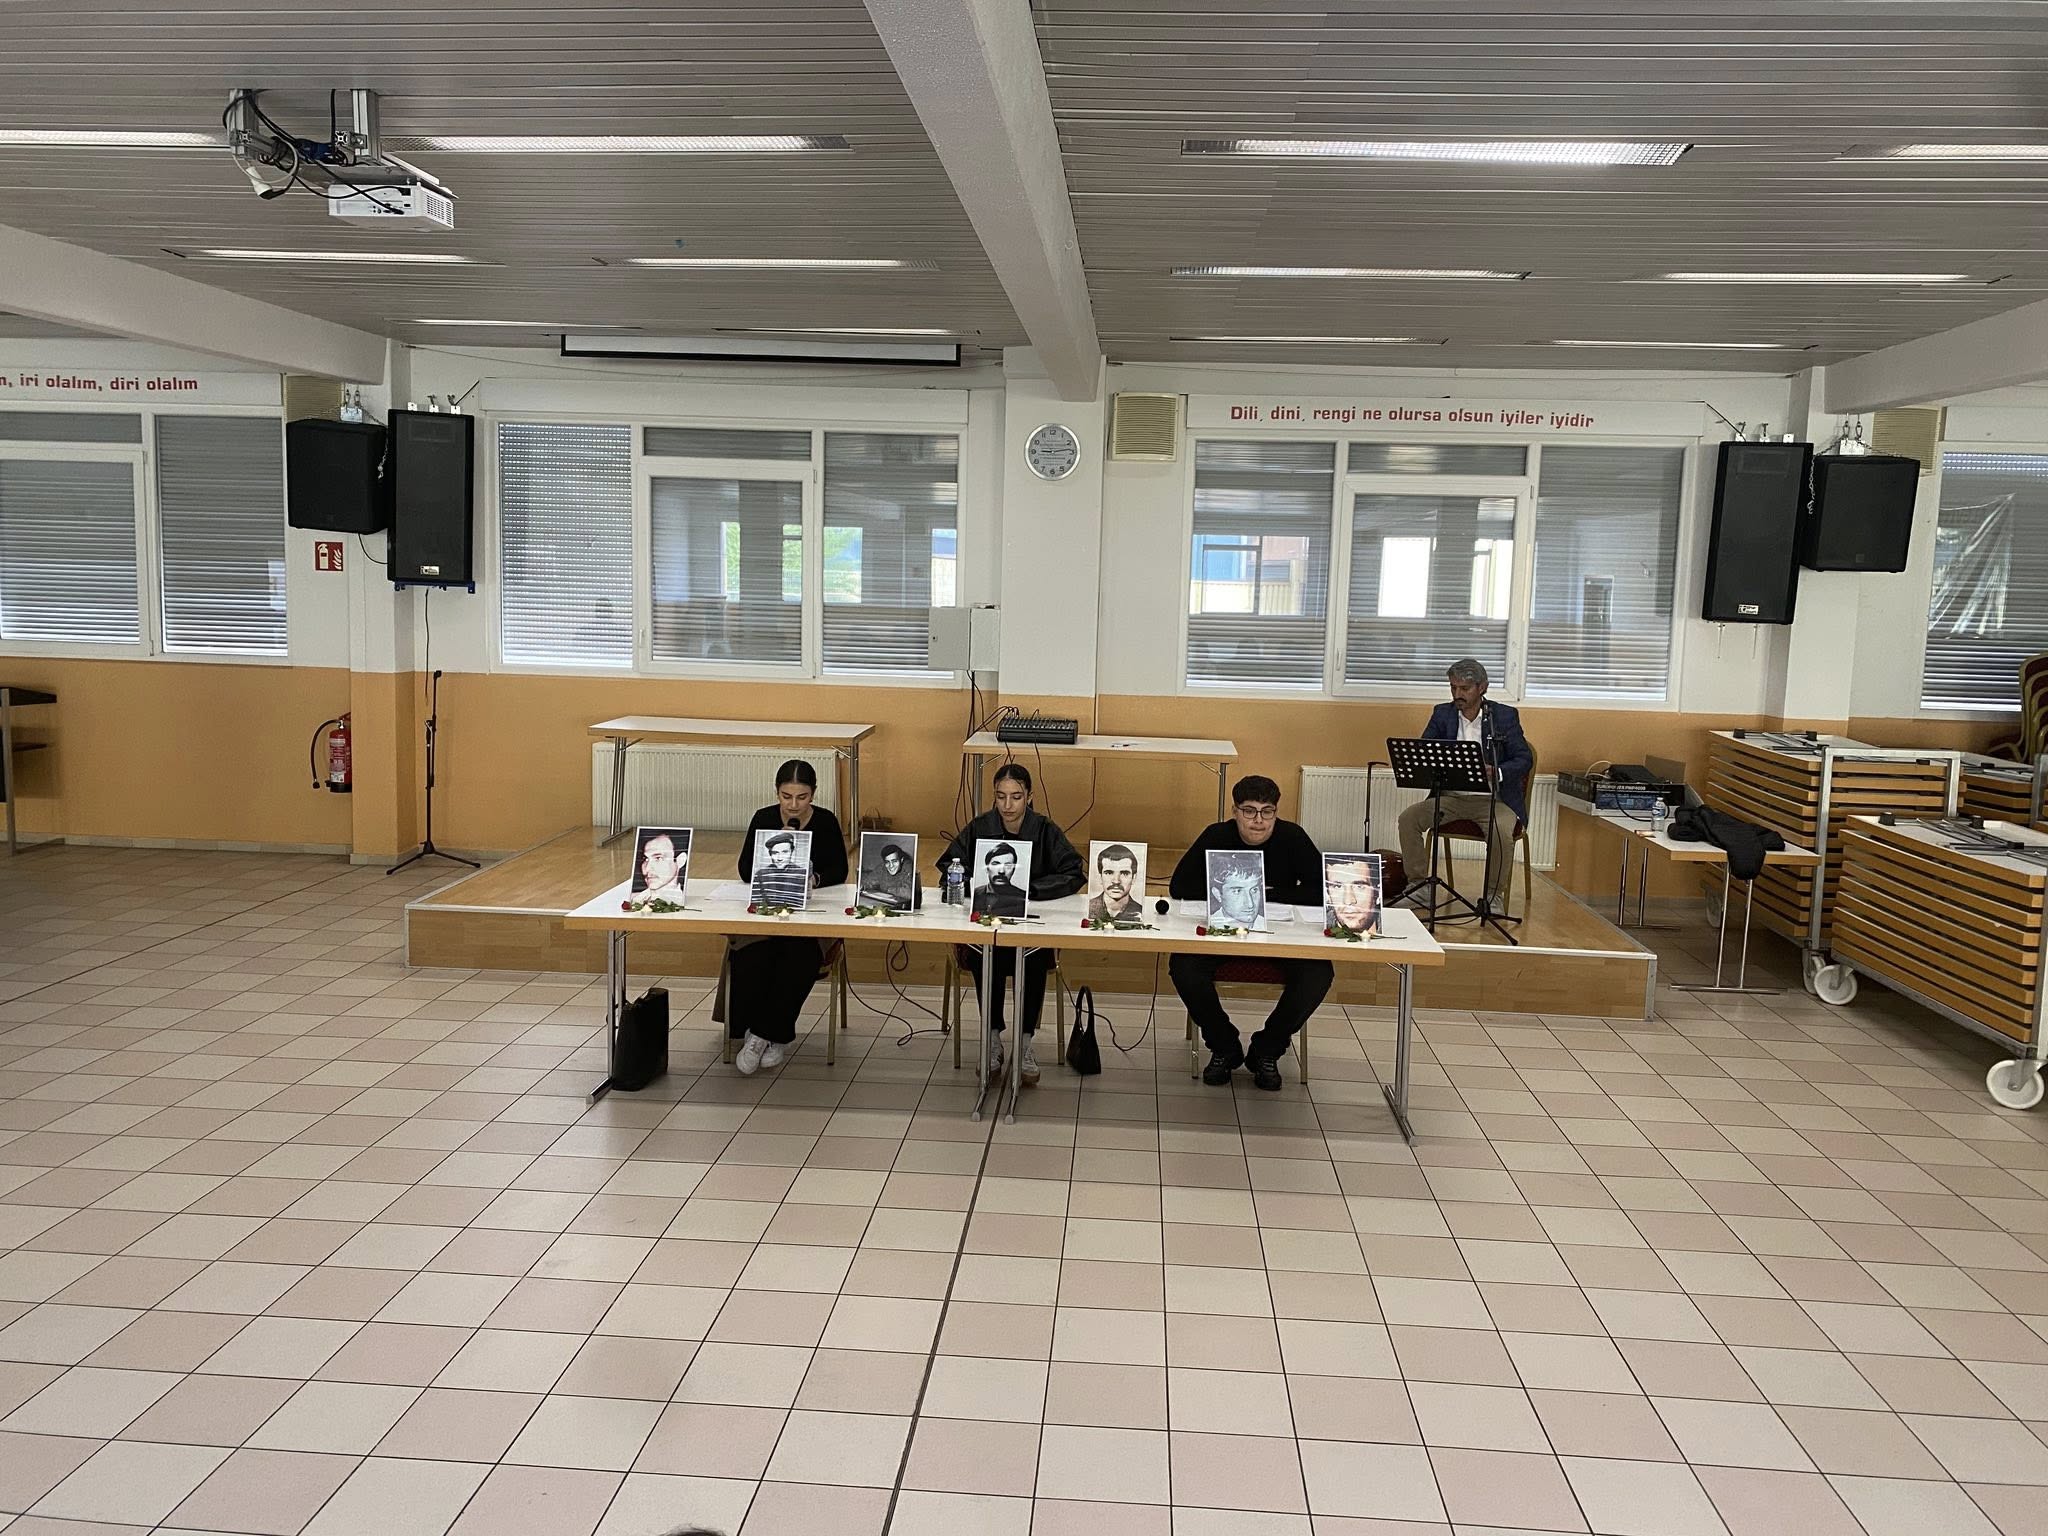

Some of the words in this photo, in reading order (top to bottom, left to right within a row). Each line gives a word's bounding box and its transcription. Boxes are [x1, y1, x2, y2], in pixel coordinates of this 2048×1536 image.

[20, 373, 39, 387] iri
[46, 375, 103, 391] olalım,
[110, 377, 139, 390] diri
[146, 377, 198, 390] olalım
[1231, 406, 1263, 422] Dili,
[1270, 406, 1305, 422] dini,
[1313, 406, 1356, 423] rengi
[1363, 409, 1382, 420] ne
[1388, 407, 1441, 421] olursa
[1448, 408, 1493, 422] olsun
[1500, 409, 1544, 426] iyiler
[1550, 412, 1594, 429] iyidir
